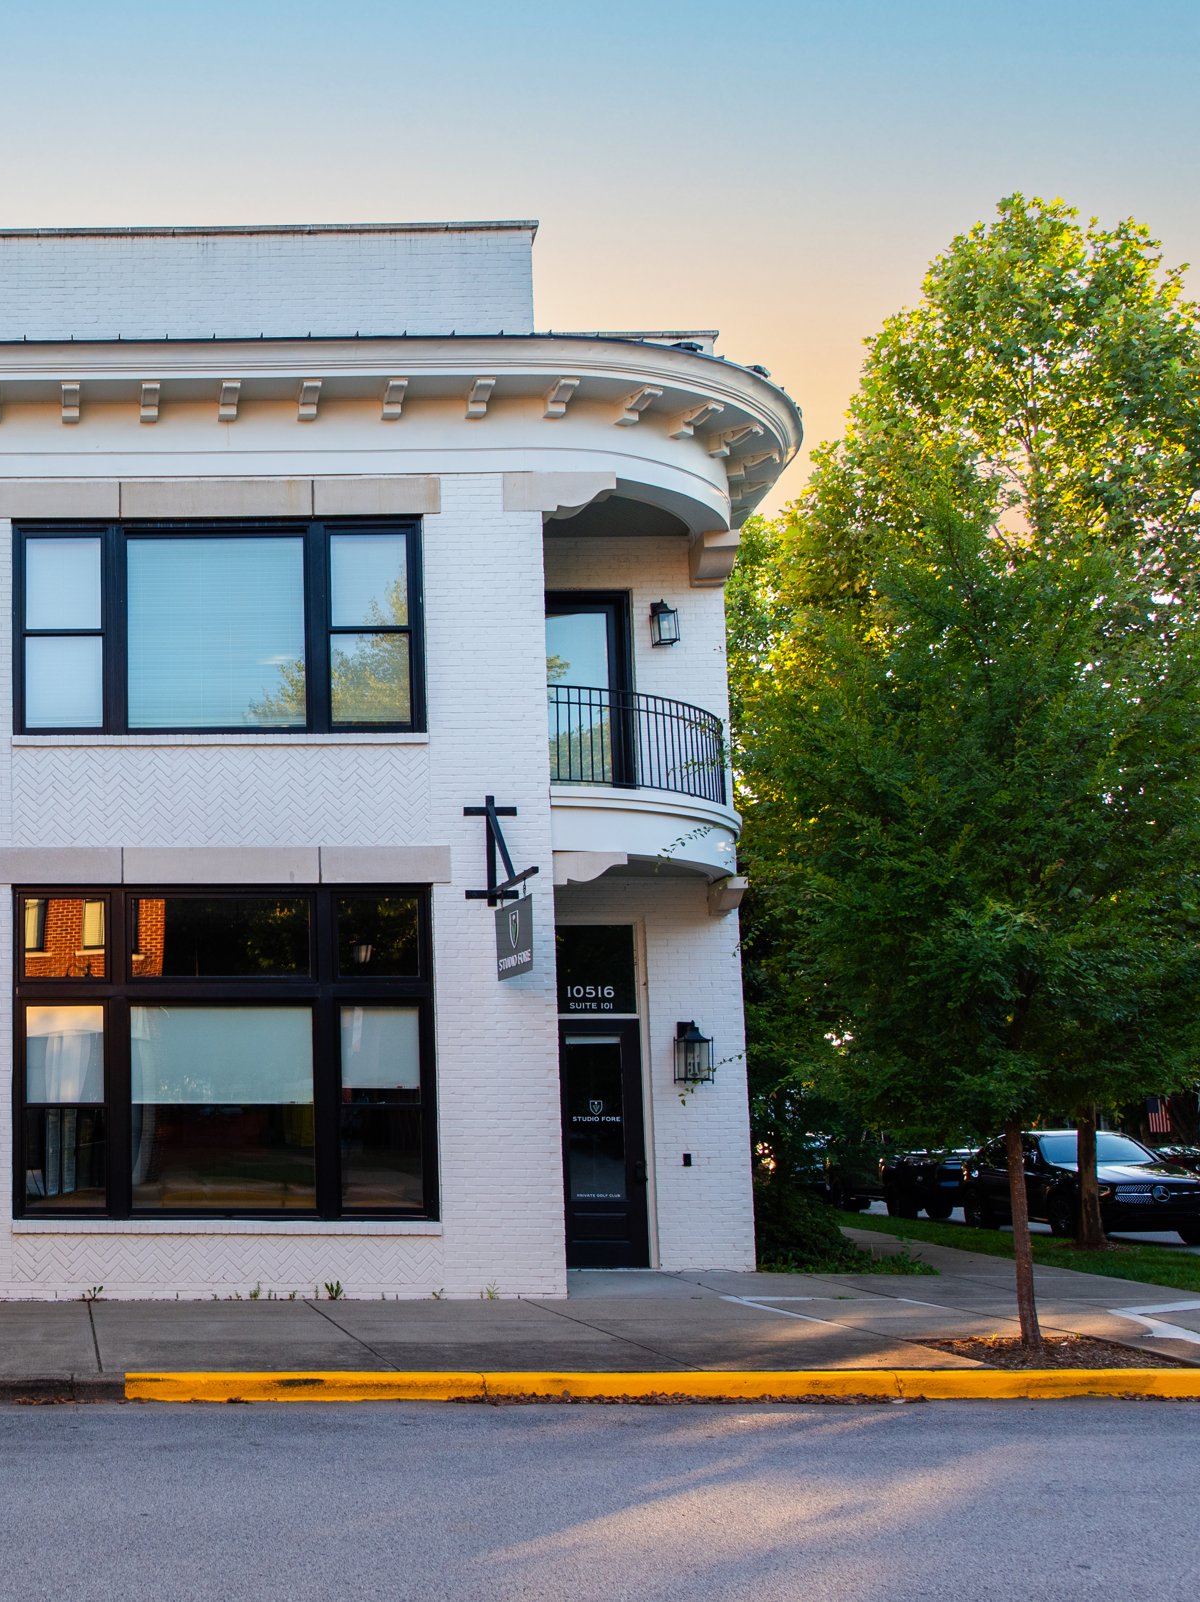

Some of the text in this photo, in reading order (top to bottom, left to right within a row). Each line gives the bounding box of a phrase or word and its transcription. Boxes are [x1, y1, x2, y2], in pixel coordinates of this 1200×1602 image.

[498, 948, 531, 972] STUDIO FORE
[567, 985, 615, 998] 10516
